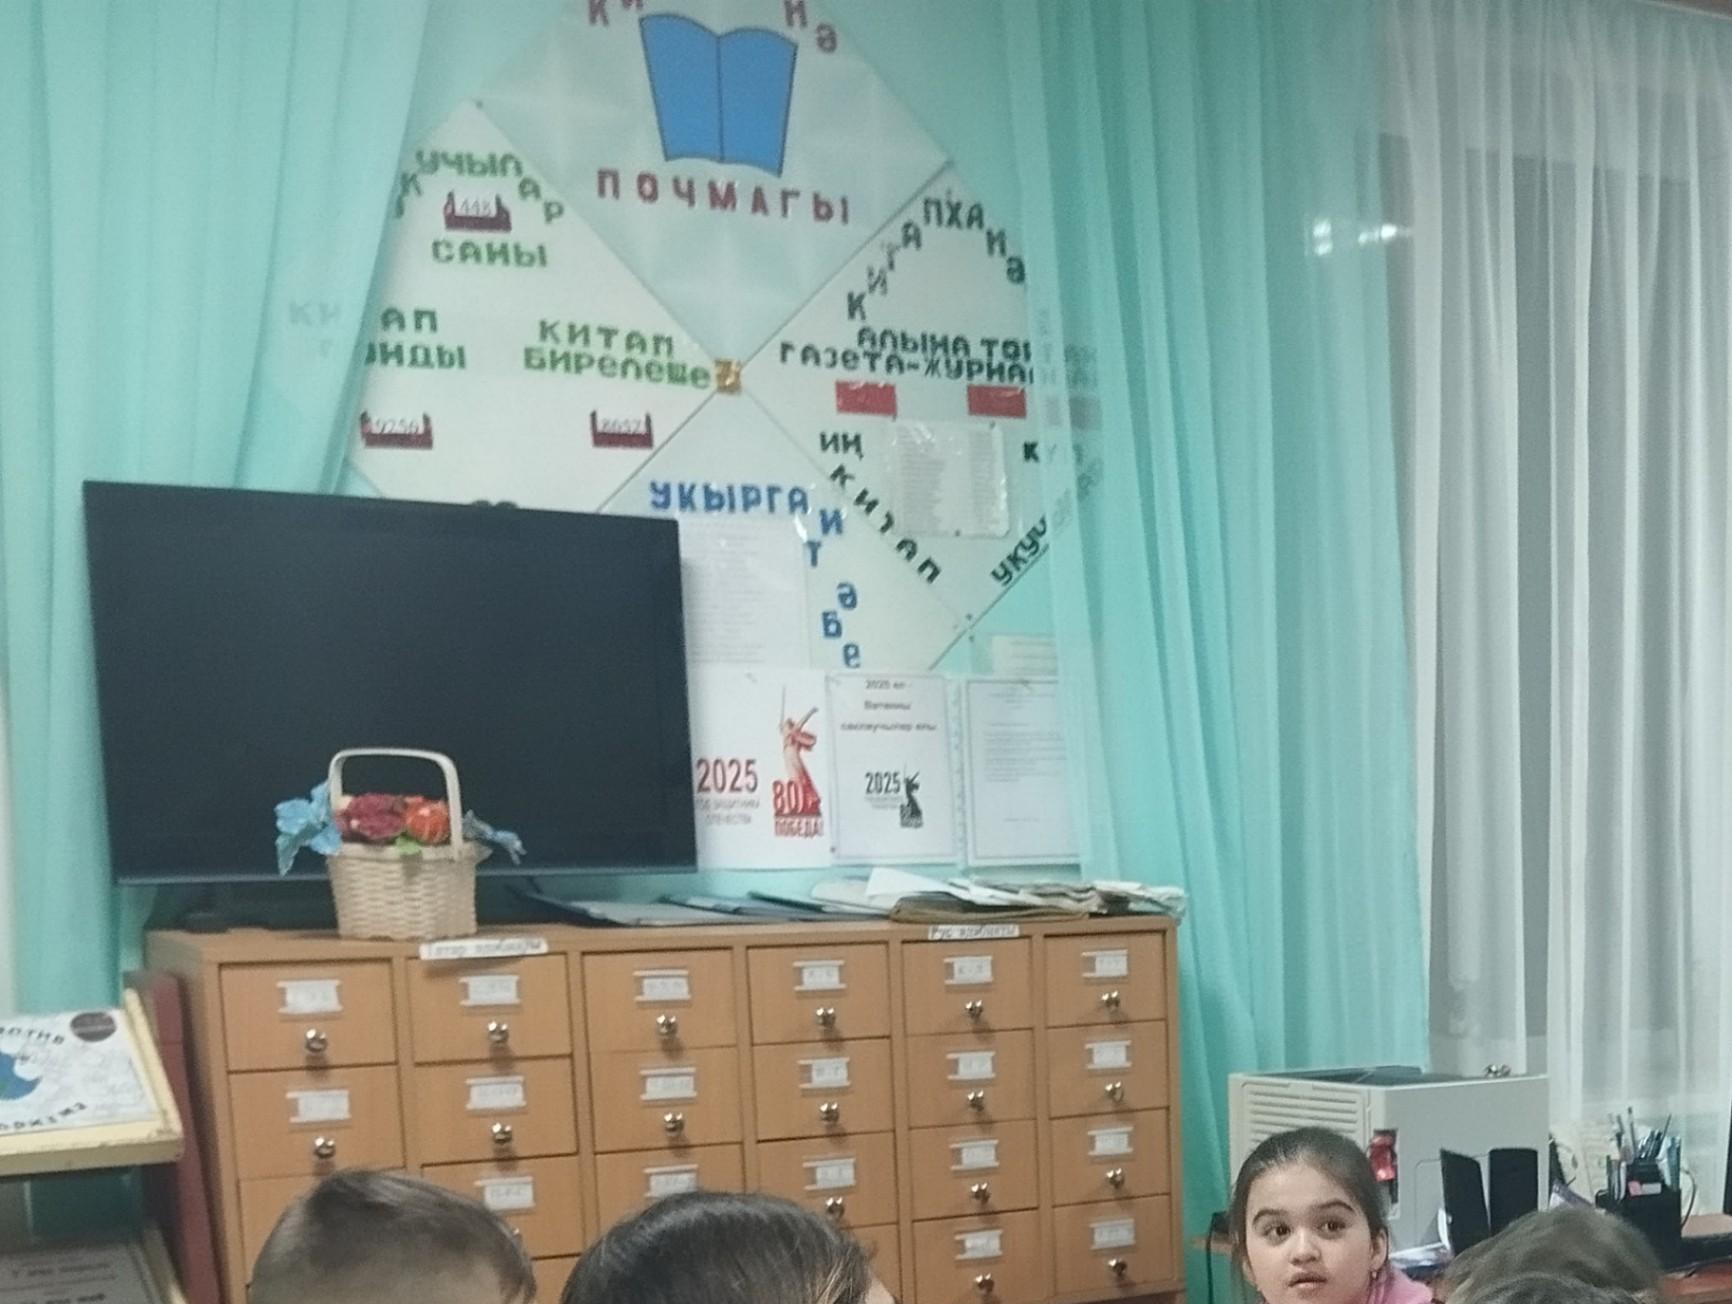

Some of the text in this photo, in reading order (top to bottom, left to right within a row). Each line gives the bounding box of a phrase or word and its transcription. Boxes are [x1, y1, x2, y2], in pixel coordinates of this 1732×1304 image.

[597, 168, 849, 225] ПОЧМАГЫ
[538, 319, 674, 356] КИТАП
[857, 326, 970, 358] АЛЫНА
[779, 341, 1034, 384] ГАЗЕТА-ЖУРНА
[650, 480, 810, 515] УКЫРГА
[830, 464, 941, 583] КИТАП
[696, 758, 758, 793] 2025
[865, 771, 901, 794] 2025
